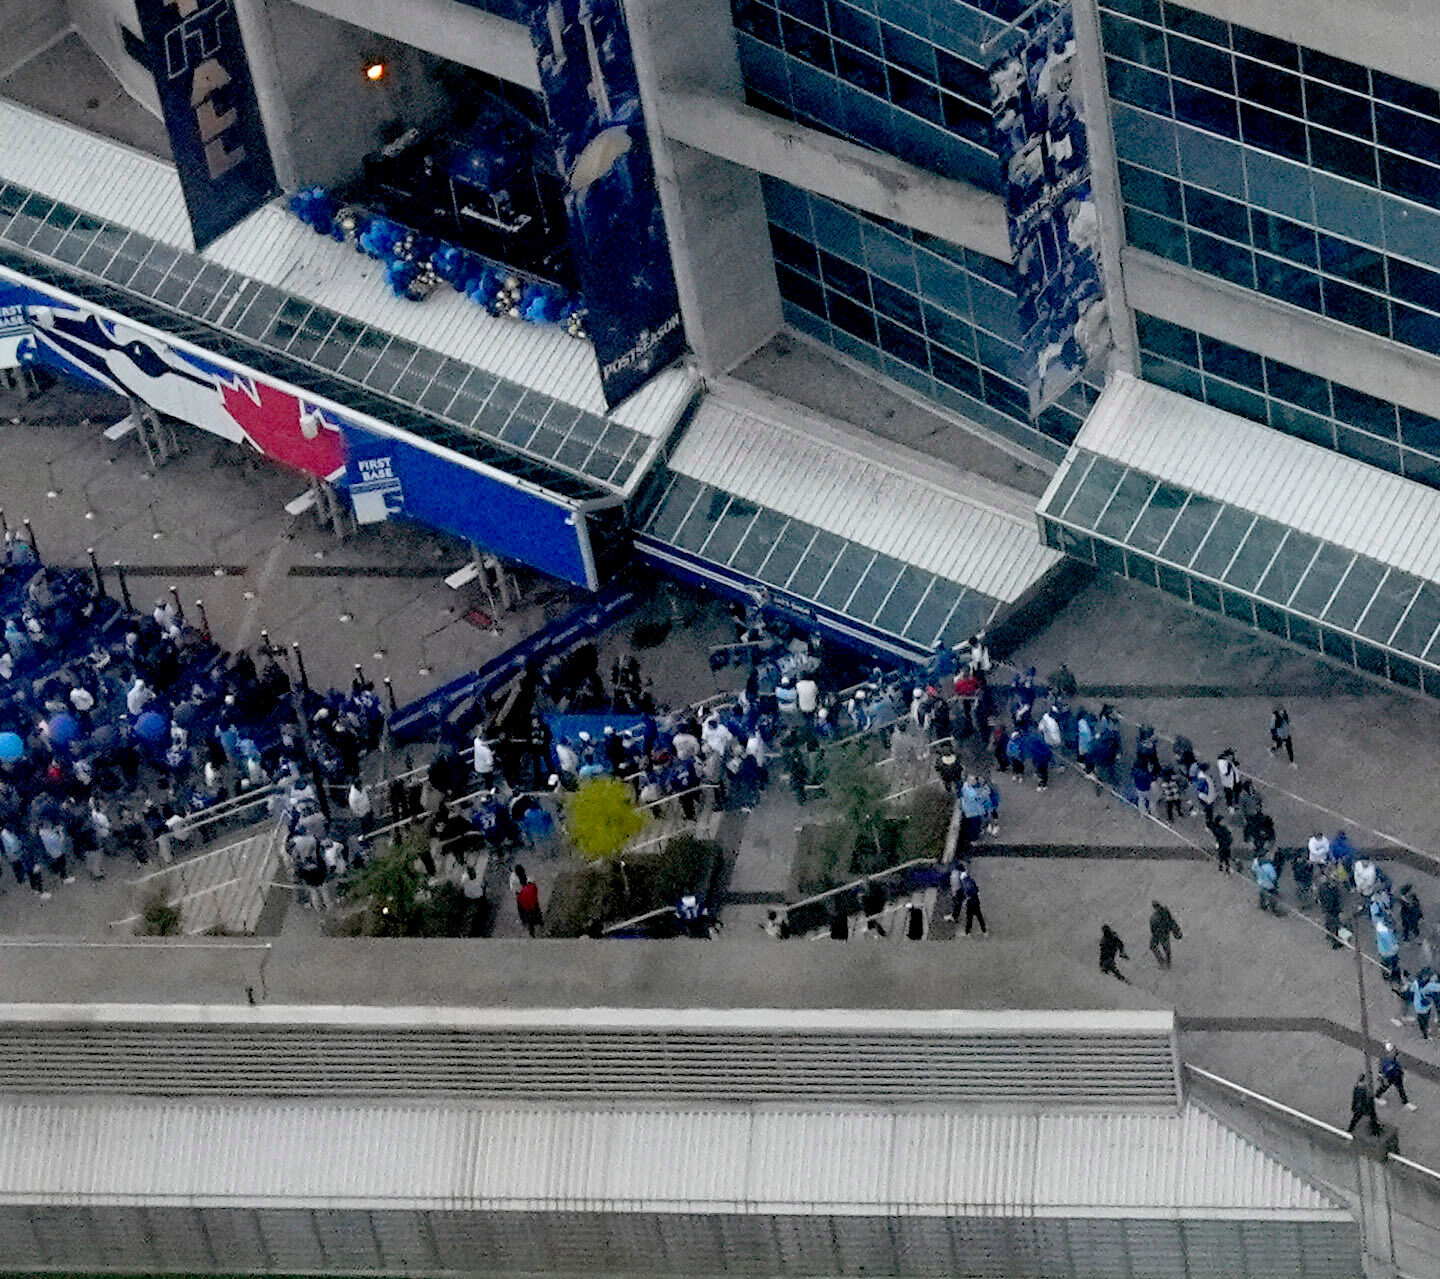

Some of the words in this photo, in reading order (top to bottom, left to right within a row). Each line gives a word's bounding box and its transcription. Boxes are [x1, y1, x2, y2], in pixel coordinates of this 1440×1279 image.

[190, 58, 246, 180] ALL
[602, 312, 680, 380] POSTSEASON
[358, 457, 391, 471] FIRST
[362, 468, 393, 481] BASE
